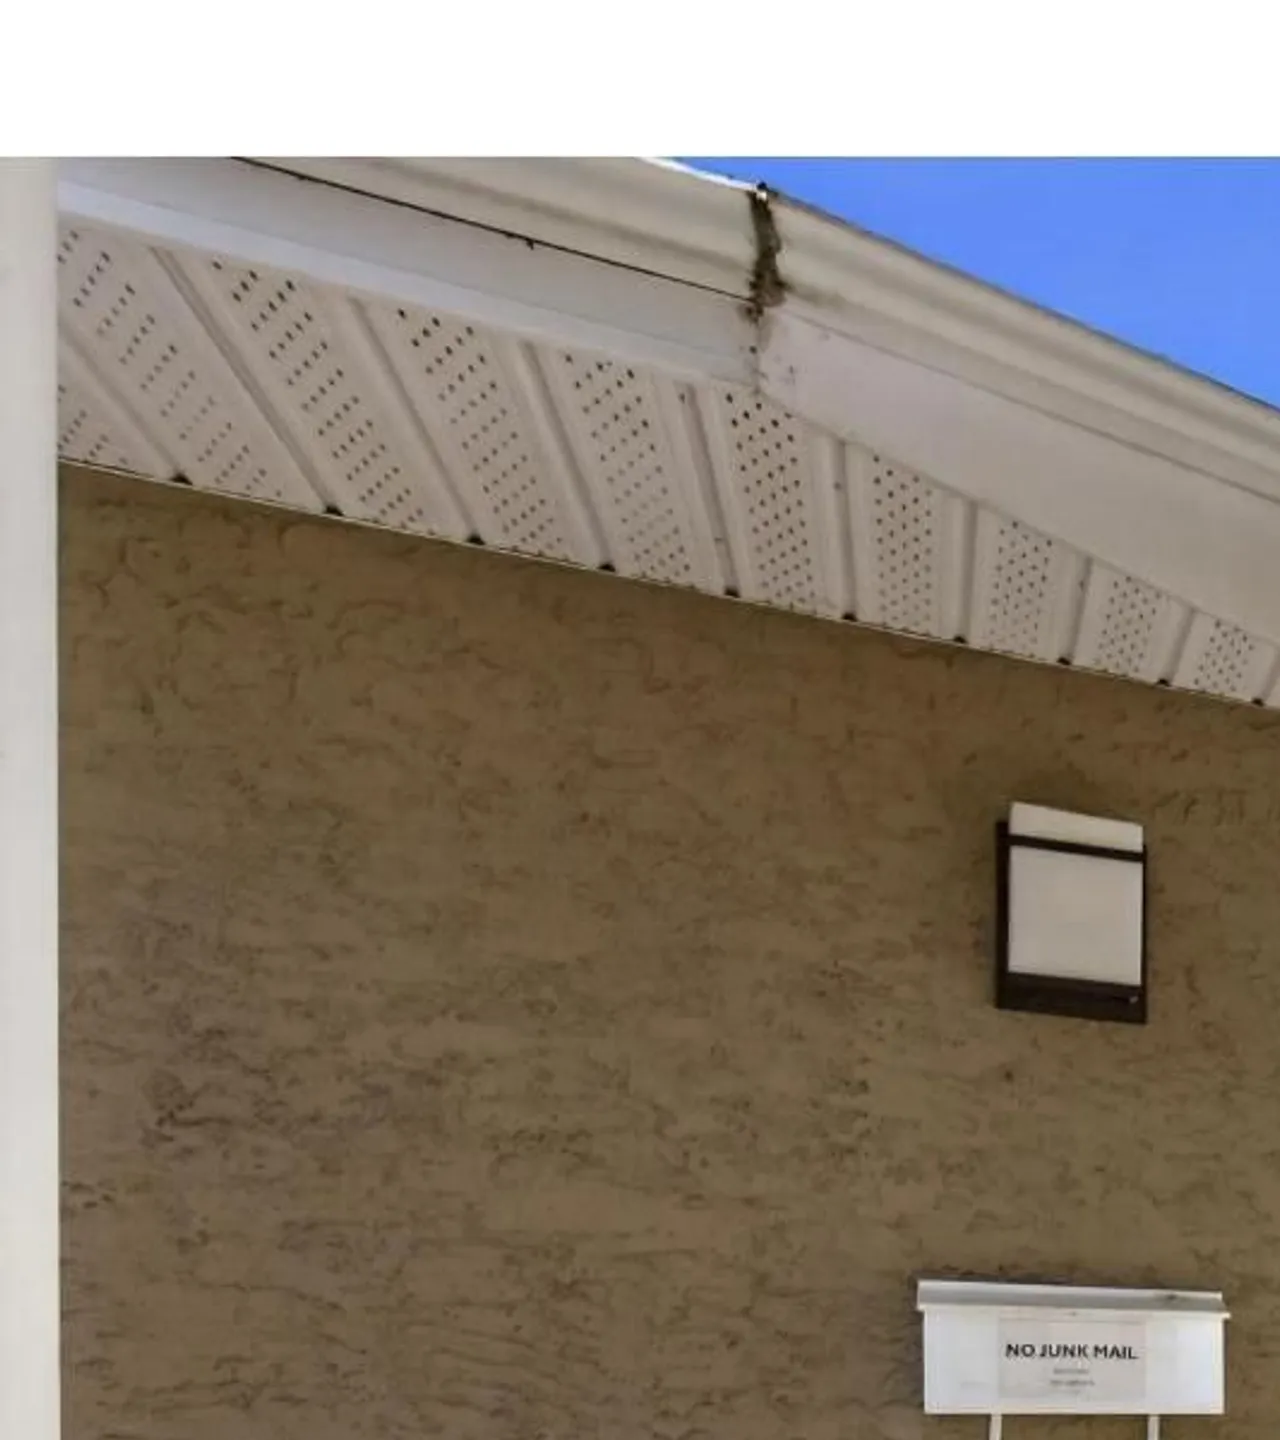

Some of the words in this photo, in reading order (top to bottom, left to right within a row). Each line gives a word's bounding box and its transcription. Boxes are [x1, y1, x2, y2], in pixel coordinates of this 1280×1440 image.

[1005, 1343, 1035, 1358] NO
[1039, 1343, 1088, 1358] JUNK
[1093, 1344, 1138, 1359] MAIL
